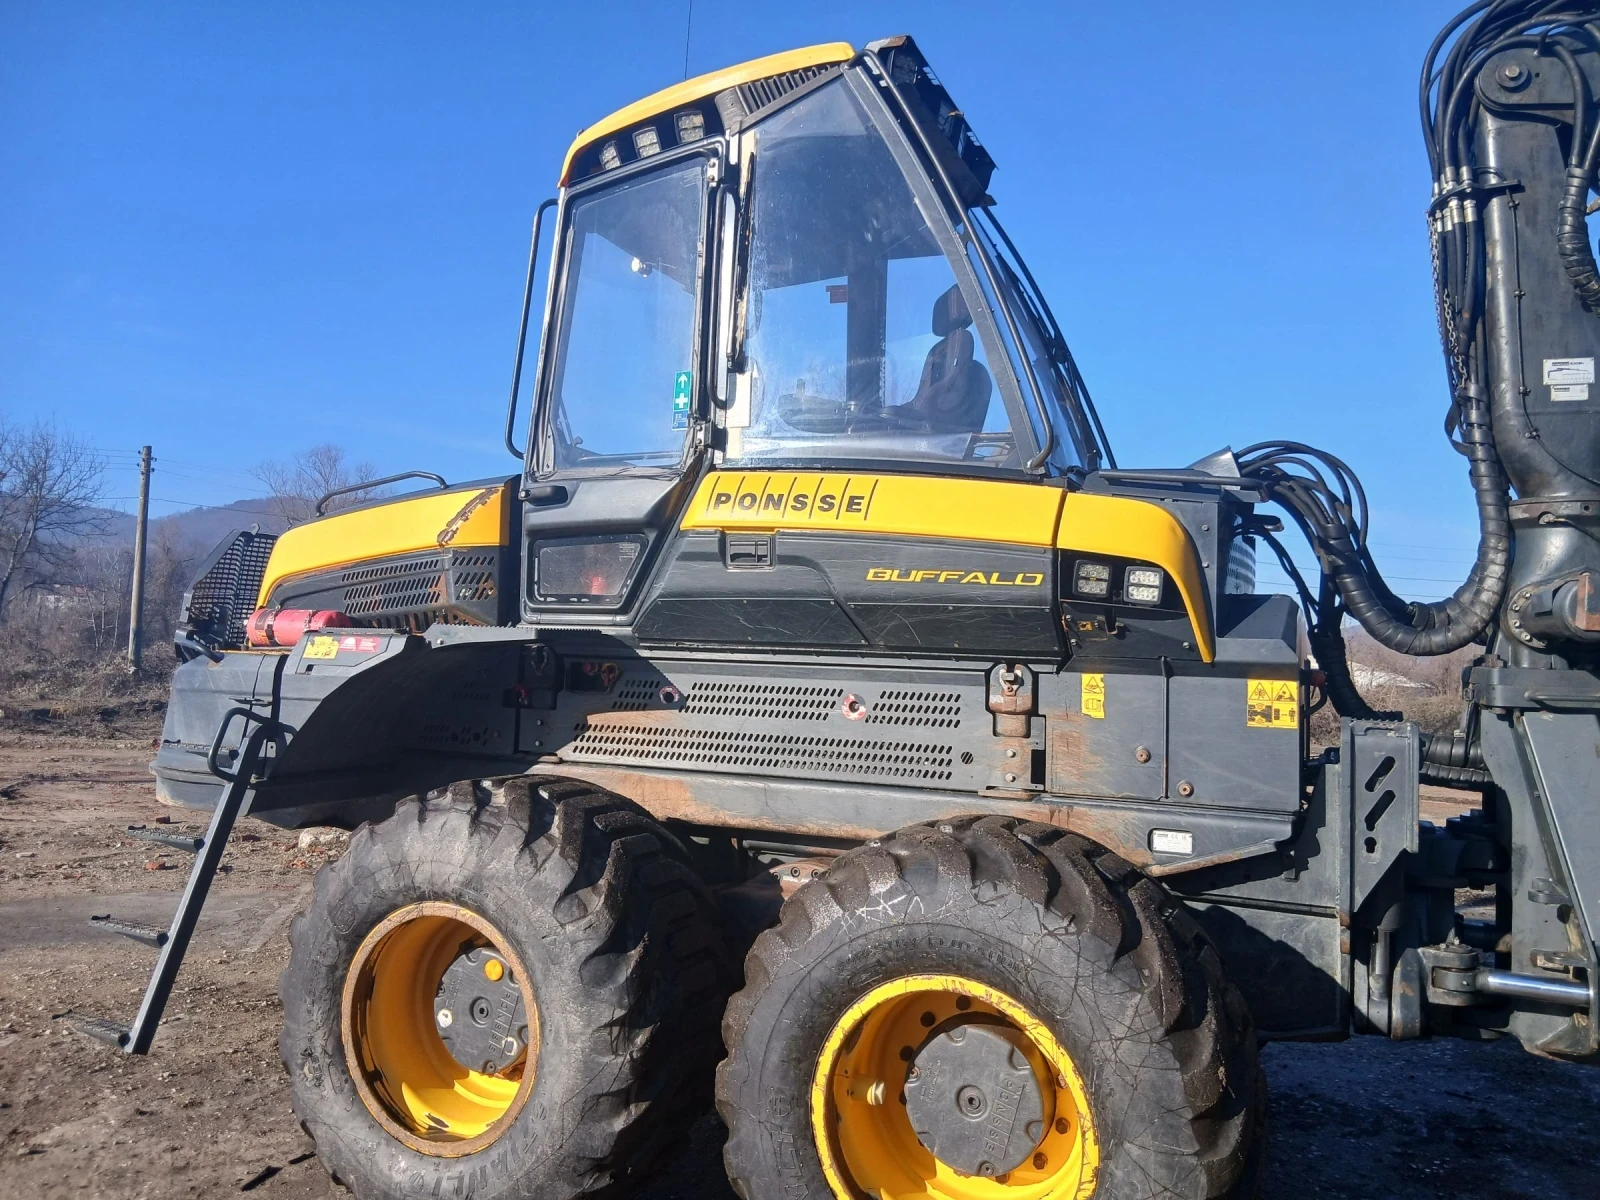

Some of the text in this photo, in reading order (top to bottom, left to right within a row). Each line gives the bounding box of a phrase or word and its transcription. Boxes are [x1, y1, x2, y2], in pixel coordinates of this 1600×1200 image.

[714, 492, 865, 513] PONSSE
[866, 568, 1043, 586] BUFFALO
[488, 992, 511, 1052] PONSSE
[985, 1078, 1013, 1151] PONSSE
